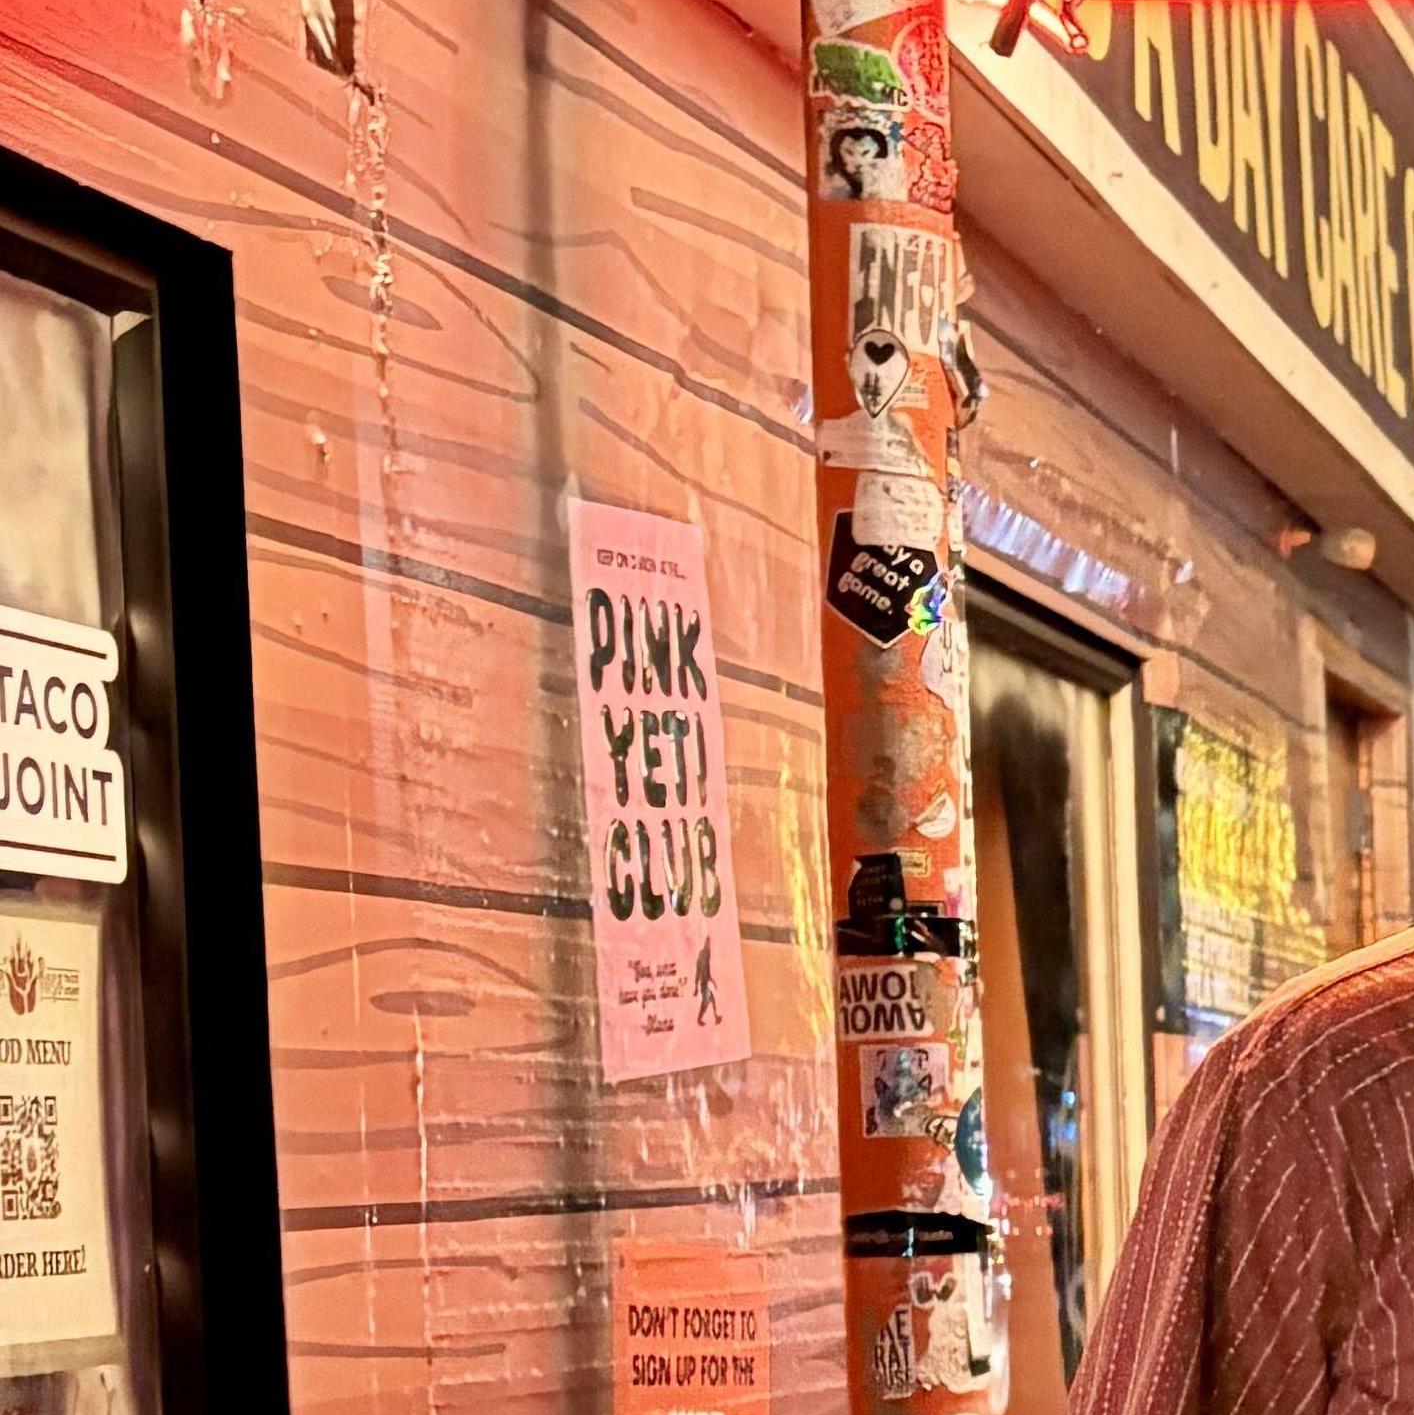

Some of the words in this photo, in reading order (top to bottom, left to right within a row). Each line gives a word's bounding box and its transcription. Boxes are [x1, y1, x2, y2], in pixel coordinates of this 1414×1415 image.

[851, 551, 910, 591] great
[585, 587, 708, 702] PINK
[0, 666, 98, 740] TACO
[601, 703, 708, 809] YETI
[0, 752, 113, 827] JOINT
[605, 815, 722, 922] CLUB
[26, 1038, 71, 1066] MENU
[0, 1252, 39, 1280] DER
[42, 1244, 87, 1276] HERE!
[628, 1304, 679, 1338] DON'T
[683, 1307, 736, 1340] FORGET
[632, 1354, 671, 1387] SIGN
[676, 1355, 696, 1387] UP
[701, 1354, 728, 1386] FOR
